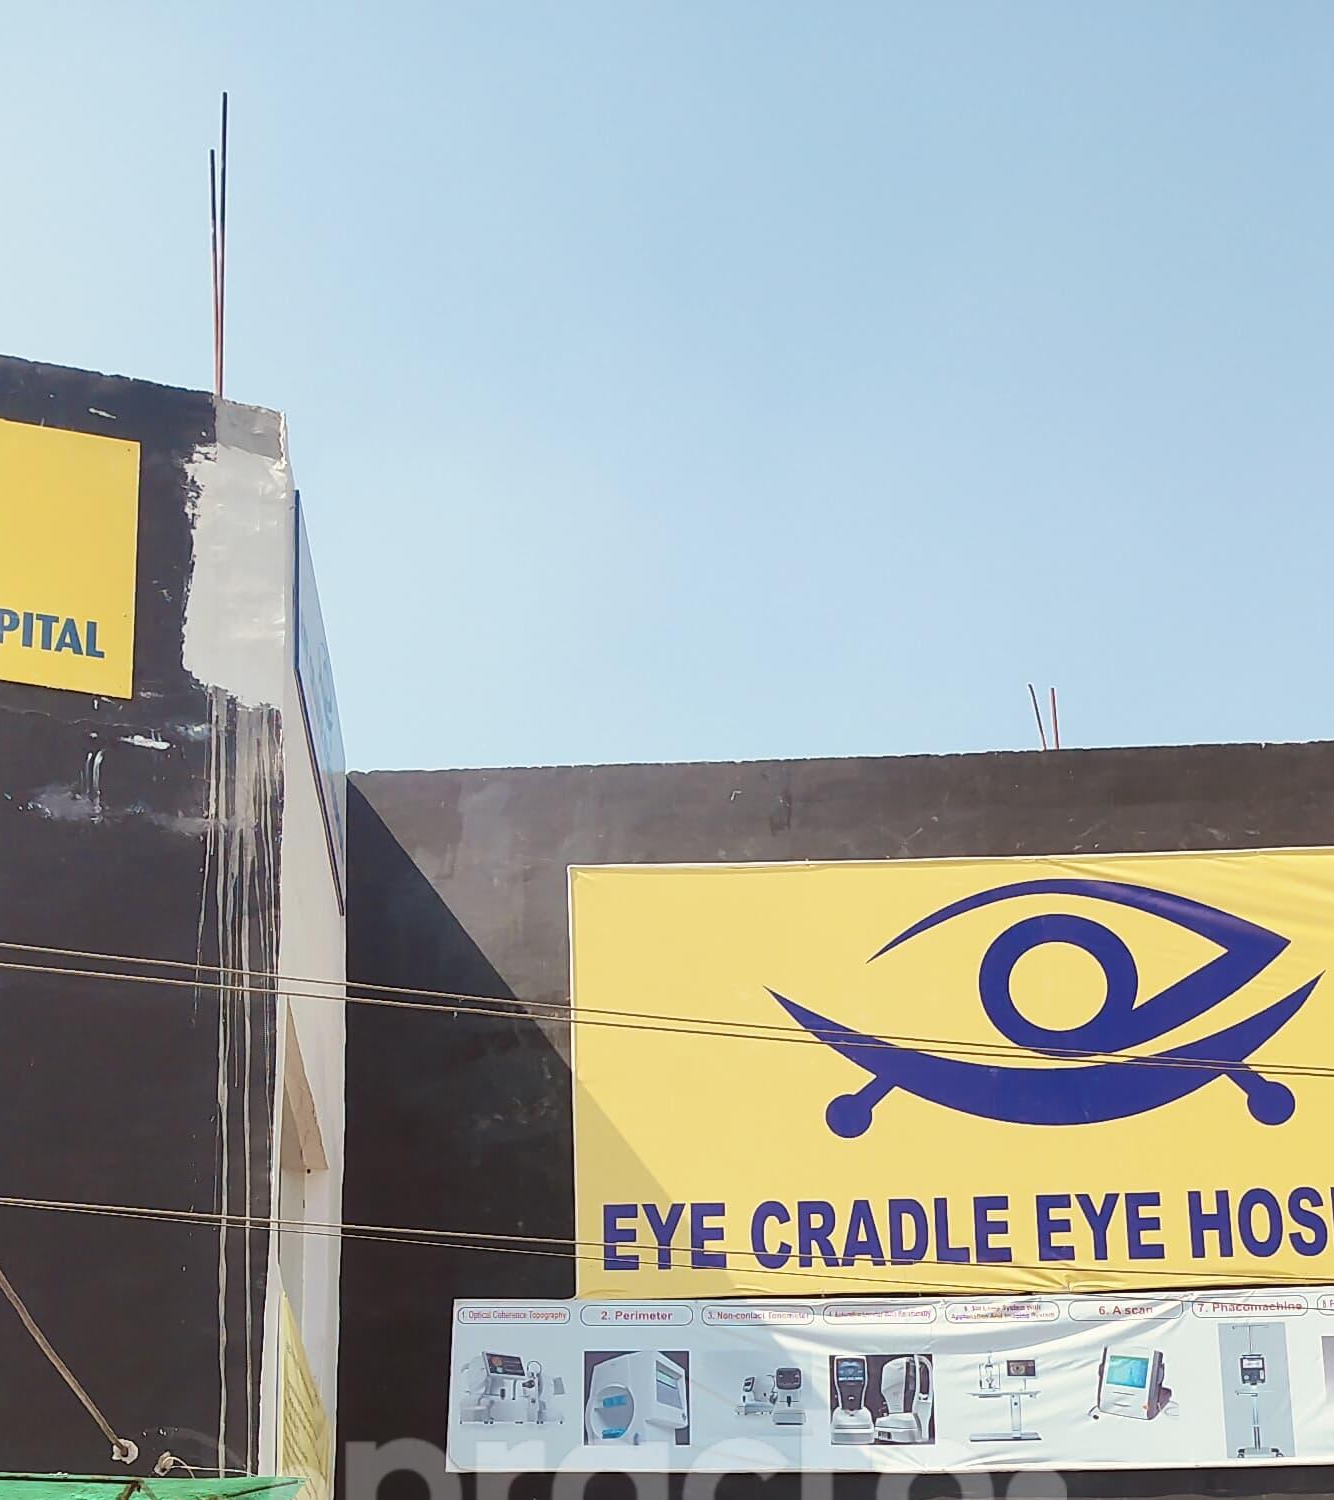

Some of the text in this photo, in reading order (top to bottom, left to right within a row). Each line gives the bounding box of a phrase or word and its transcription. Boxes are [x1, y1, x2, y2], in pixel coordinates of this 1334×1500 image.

[602, 1201, 727, 1272] EYE
[748, 1194, 1012, 1270] CRADLE
[1034, 1190, 1166, 1262] EYE
[1098, 1305, 1153, 1315] 6. A scan
[1198, 1302, 1303, 1313] 7. Phacomachine
[601, 1311, 673, 1320] 2. Perimeter
